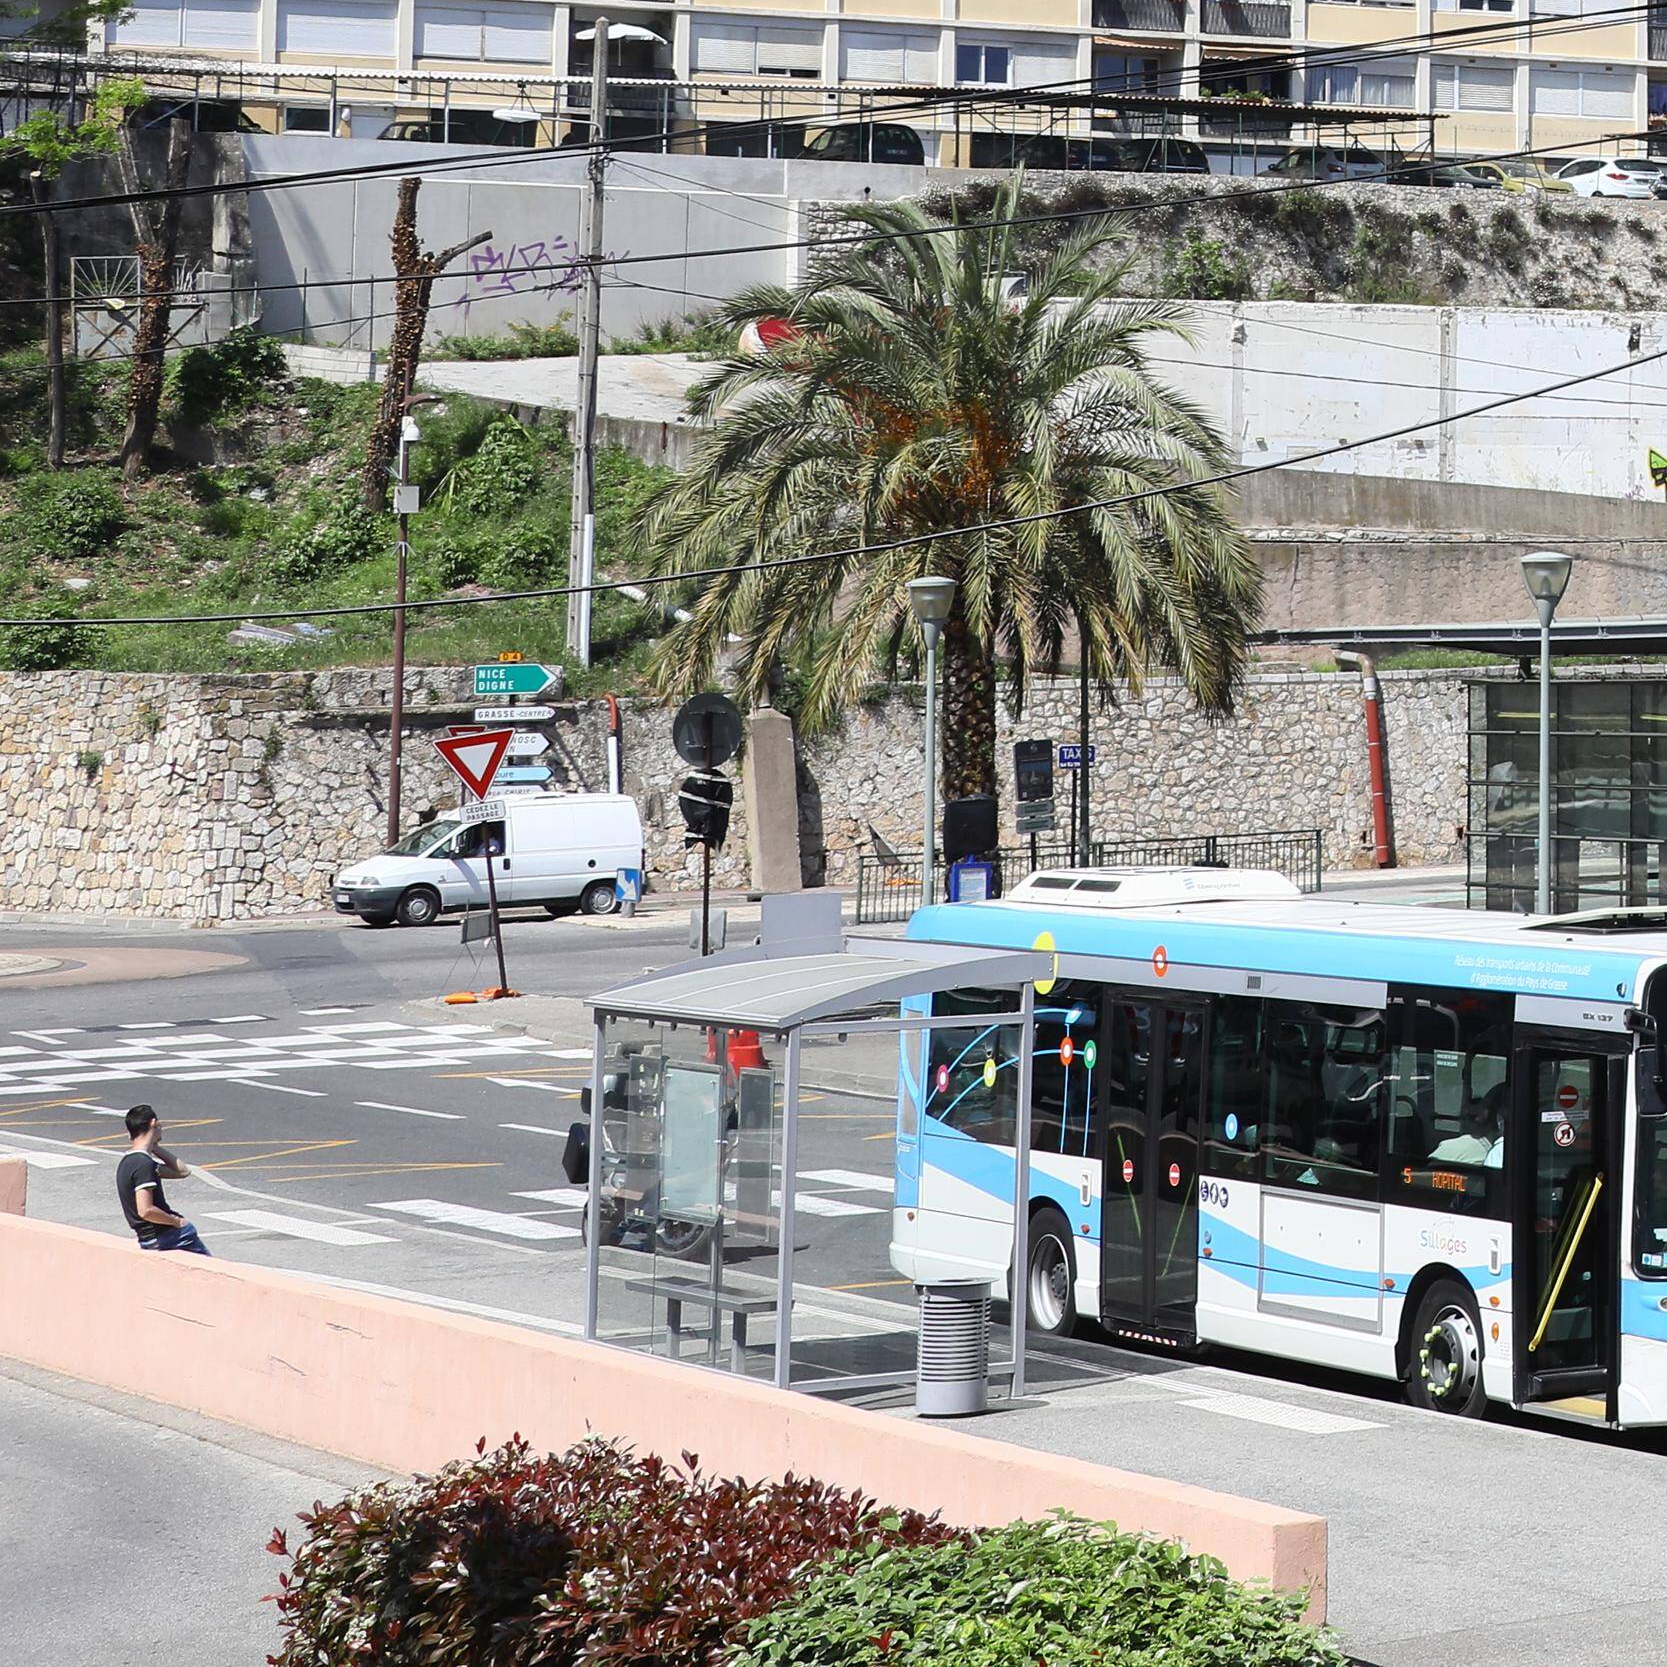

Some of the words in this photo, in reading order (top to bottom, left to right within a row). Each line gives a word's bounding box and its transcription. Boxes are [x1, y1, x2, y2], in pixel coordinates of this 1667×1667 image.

[478, 669, 506, 679] NICE
[478, 680, 514, 691] DIGNE
[1061, 747, 1093, 760] TAXS
[466, 811, 499, 821] PASSAGE
[1402, 1167, 1412, 1184] 5
[1431, 1171, 1468, 1192] HOPITAL
